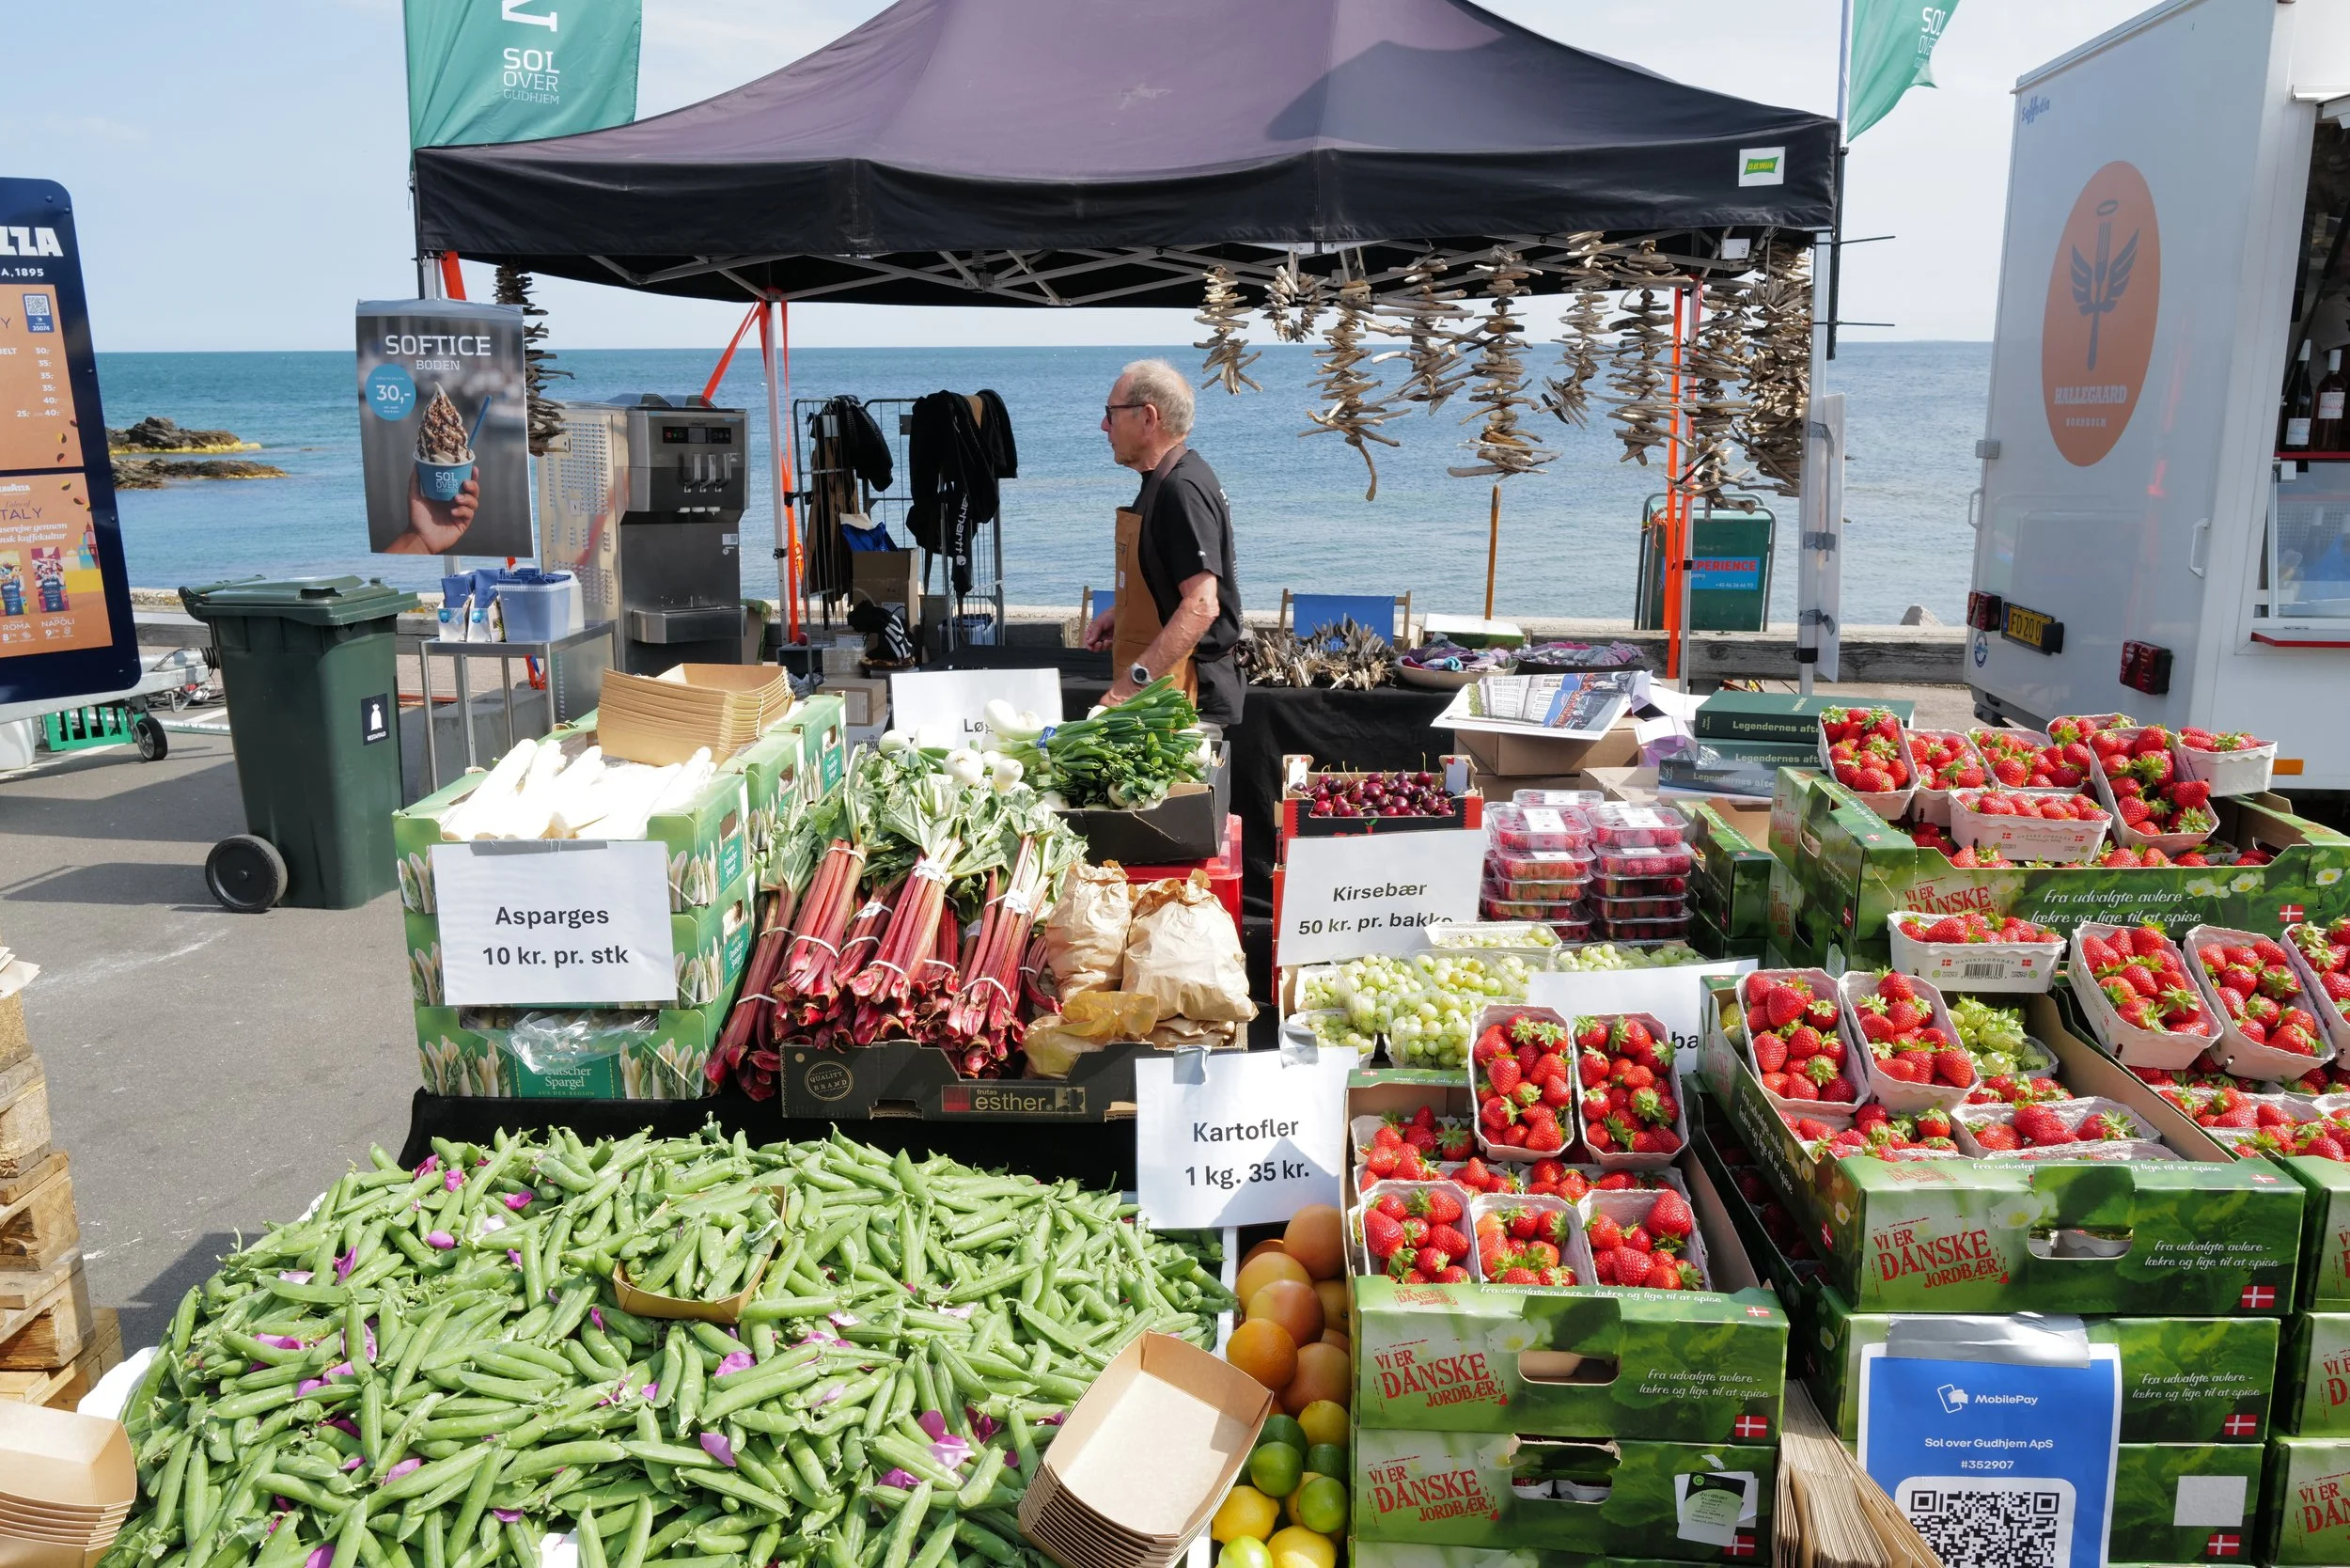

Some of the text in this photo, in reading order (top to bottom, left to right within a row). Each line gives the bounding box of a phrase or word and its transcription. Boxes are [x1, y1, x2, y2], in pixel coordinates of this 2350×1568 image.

[503, 47, 560, 73] SOL
[503, 71, 558, 92] OVER
[503, 88, 560, 104] GUDHJEM
[384, 335, 492, 356] SOFTICE
[415, 360, 461, 370] BODEN
[376, 384, 411, 404] 30,-
[2054, 384, 2128, 404] HALLEGAARD
[435, 472, 458, 481] SOL
[435, 480, 459, 489] OVER
[3, 622, 31, 631] ROMA
[41, 619, 75, 628] NAPOLI
[1732, 720, 1821, 733] Legendernes afte
[1735, 753, 1800, 765] Legendernes
[1755, 777, 1775, 788] afte
[1333, 883, 1427, 902] Kirsebær
[1904, 886, 1935, 902] VI ER
[2044, 889, 2183, 908] Fra udvalgte avlere
[495, 906, 609, 929] Asparges
[1298, 919, 1324, 935] 50
[1328, 918, 1352, 933] kr.
[1357, 915, 1383, 933] pr.
[2030, 910, 2070, 923] lækre
[2127, 910, 2144, 923] til
[2164, 911, 2201, 928] spise
[482, 945, 630, 969] 10 kr. pr. stk
[545, 1075, 585, 1090] Spargel
[809, 1071, 843, 1083] QUALITY
[813, 1079, 847, 1091] BRAND
[1194, 1119, 1299, 1143] Kartofler
[1185, 1160, 1309, 1190] 1 kg. 35 kr.
[1995, 1163, 2035, 1172] udvalgt
[1873, 1229, 1916, 1251] VI ER
[2154, 1240, 2263, 1255] Fra udvalgte avlere
[1877, 1230, 1992, 1282] DANSKE
[2145, 1256, 2175, 1266] lækre
[2179, 1260, 2193, 1270] og
[2197, 1257, 2216, 1270] lige
[2220, 1257, 2232, 1266] til
[2248, 1258, 2279, 1270] spise
[1923, 1258, 1999, 1289] JORDBÆR
[1398, 1289, 1449, 1304] DANSKE
[1480, 1286, 1499, 1294] Fra
[1594, 1290, 1624, 1299] lækre
[1627, 1292, 1640, 1301] og
[1644, 1289, 1663, 1302] lige
[1666, 1291, 1676, 1301] til
[1694, 1294, 1722, 1304] spise
[1374, 1349, 1416, 1370] VI ER
[2323, 1360, 2340, 1376] VI
[1380, 1353, 1490, 1400] DANSKE
[1648, 1369, 1753, 1385] Fra udvalgte avlere
[2142, 1372, 2246, 1387] Fra udvalgte avlere
[1426, 1380, 1498, 1407] JORDBÆR
[1639, 1384, 1668, 1394] lækre
[1672, 1388, 1685, 1399] og
[1689, 1386, 1708, 1399] lige
[1713, 1387, 1724, 1396] til
[1740, 1388, 1768, 1401] spise
[1975, 1395, 2038, 1405] MobilePay
[2132, 1388, 2260, 1402] lækre og lige til at spise
[1924, 1438, 1944, 1448] Sol
[1973, 1438, 2028, 1450] Gudhjem
[2029, 1439, 2054, 1450] ApS
[1961, 1460, 2014, 1469] #352907
[1369, 1466, 1408, 1484] VI ER
[1373, 1469, 1481, 1514] DANSKE
[2299, 1482, 2340, 1504] VI ER
[1418, 1497, 1490, 1522] JORDBÆR
